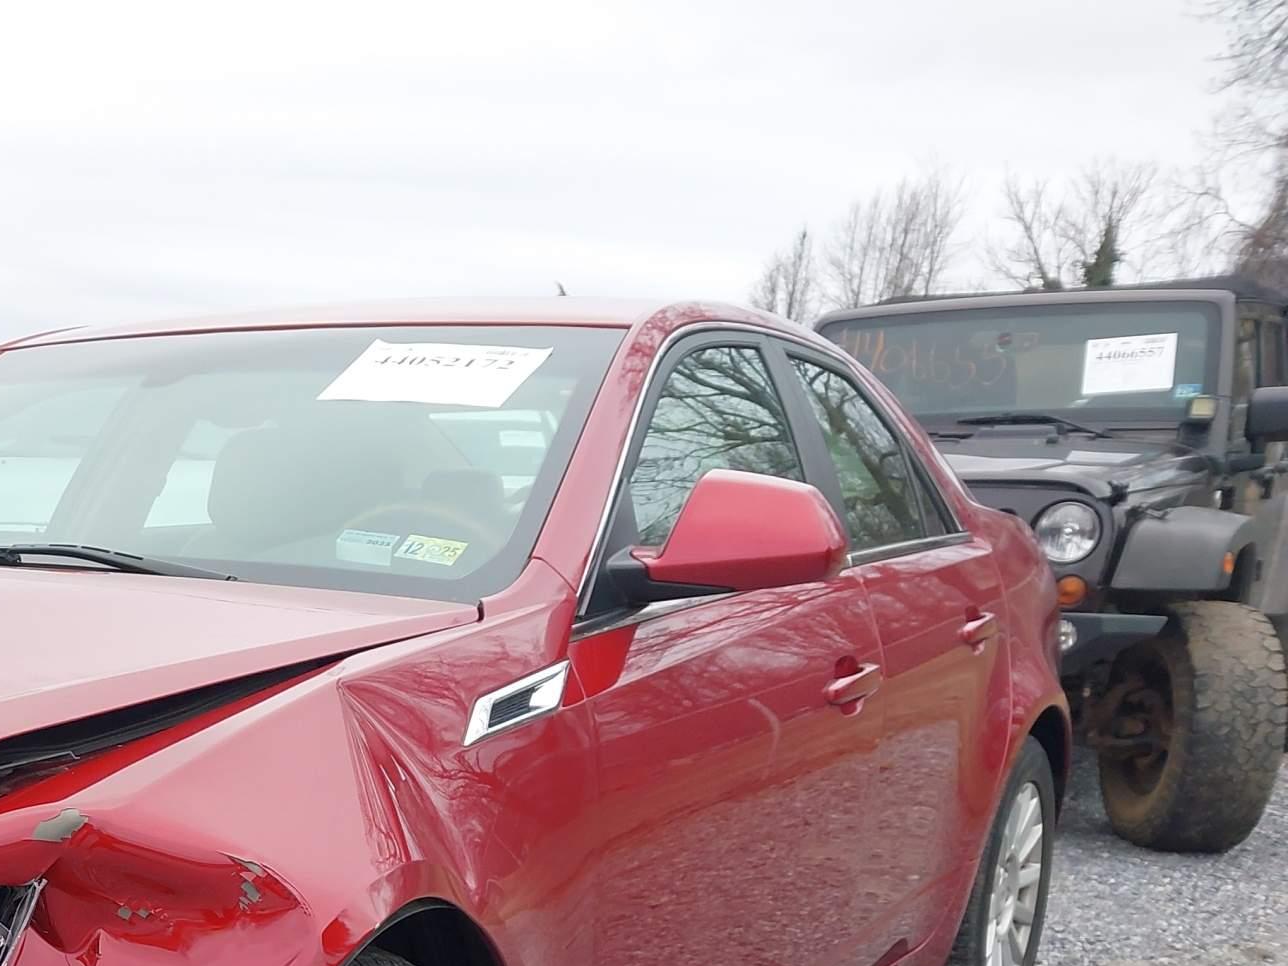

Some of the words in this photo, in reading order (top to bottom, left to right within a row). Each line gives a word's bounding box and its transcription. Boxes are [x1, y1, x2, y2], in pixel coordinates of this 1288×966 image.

[375, 355, 515, 370] 44052172
[403, 541, 425, 555] 12
[440, 545, 461, 557] 25
